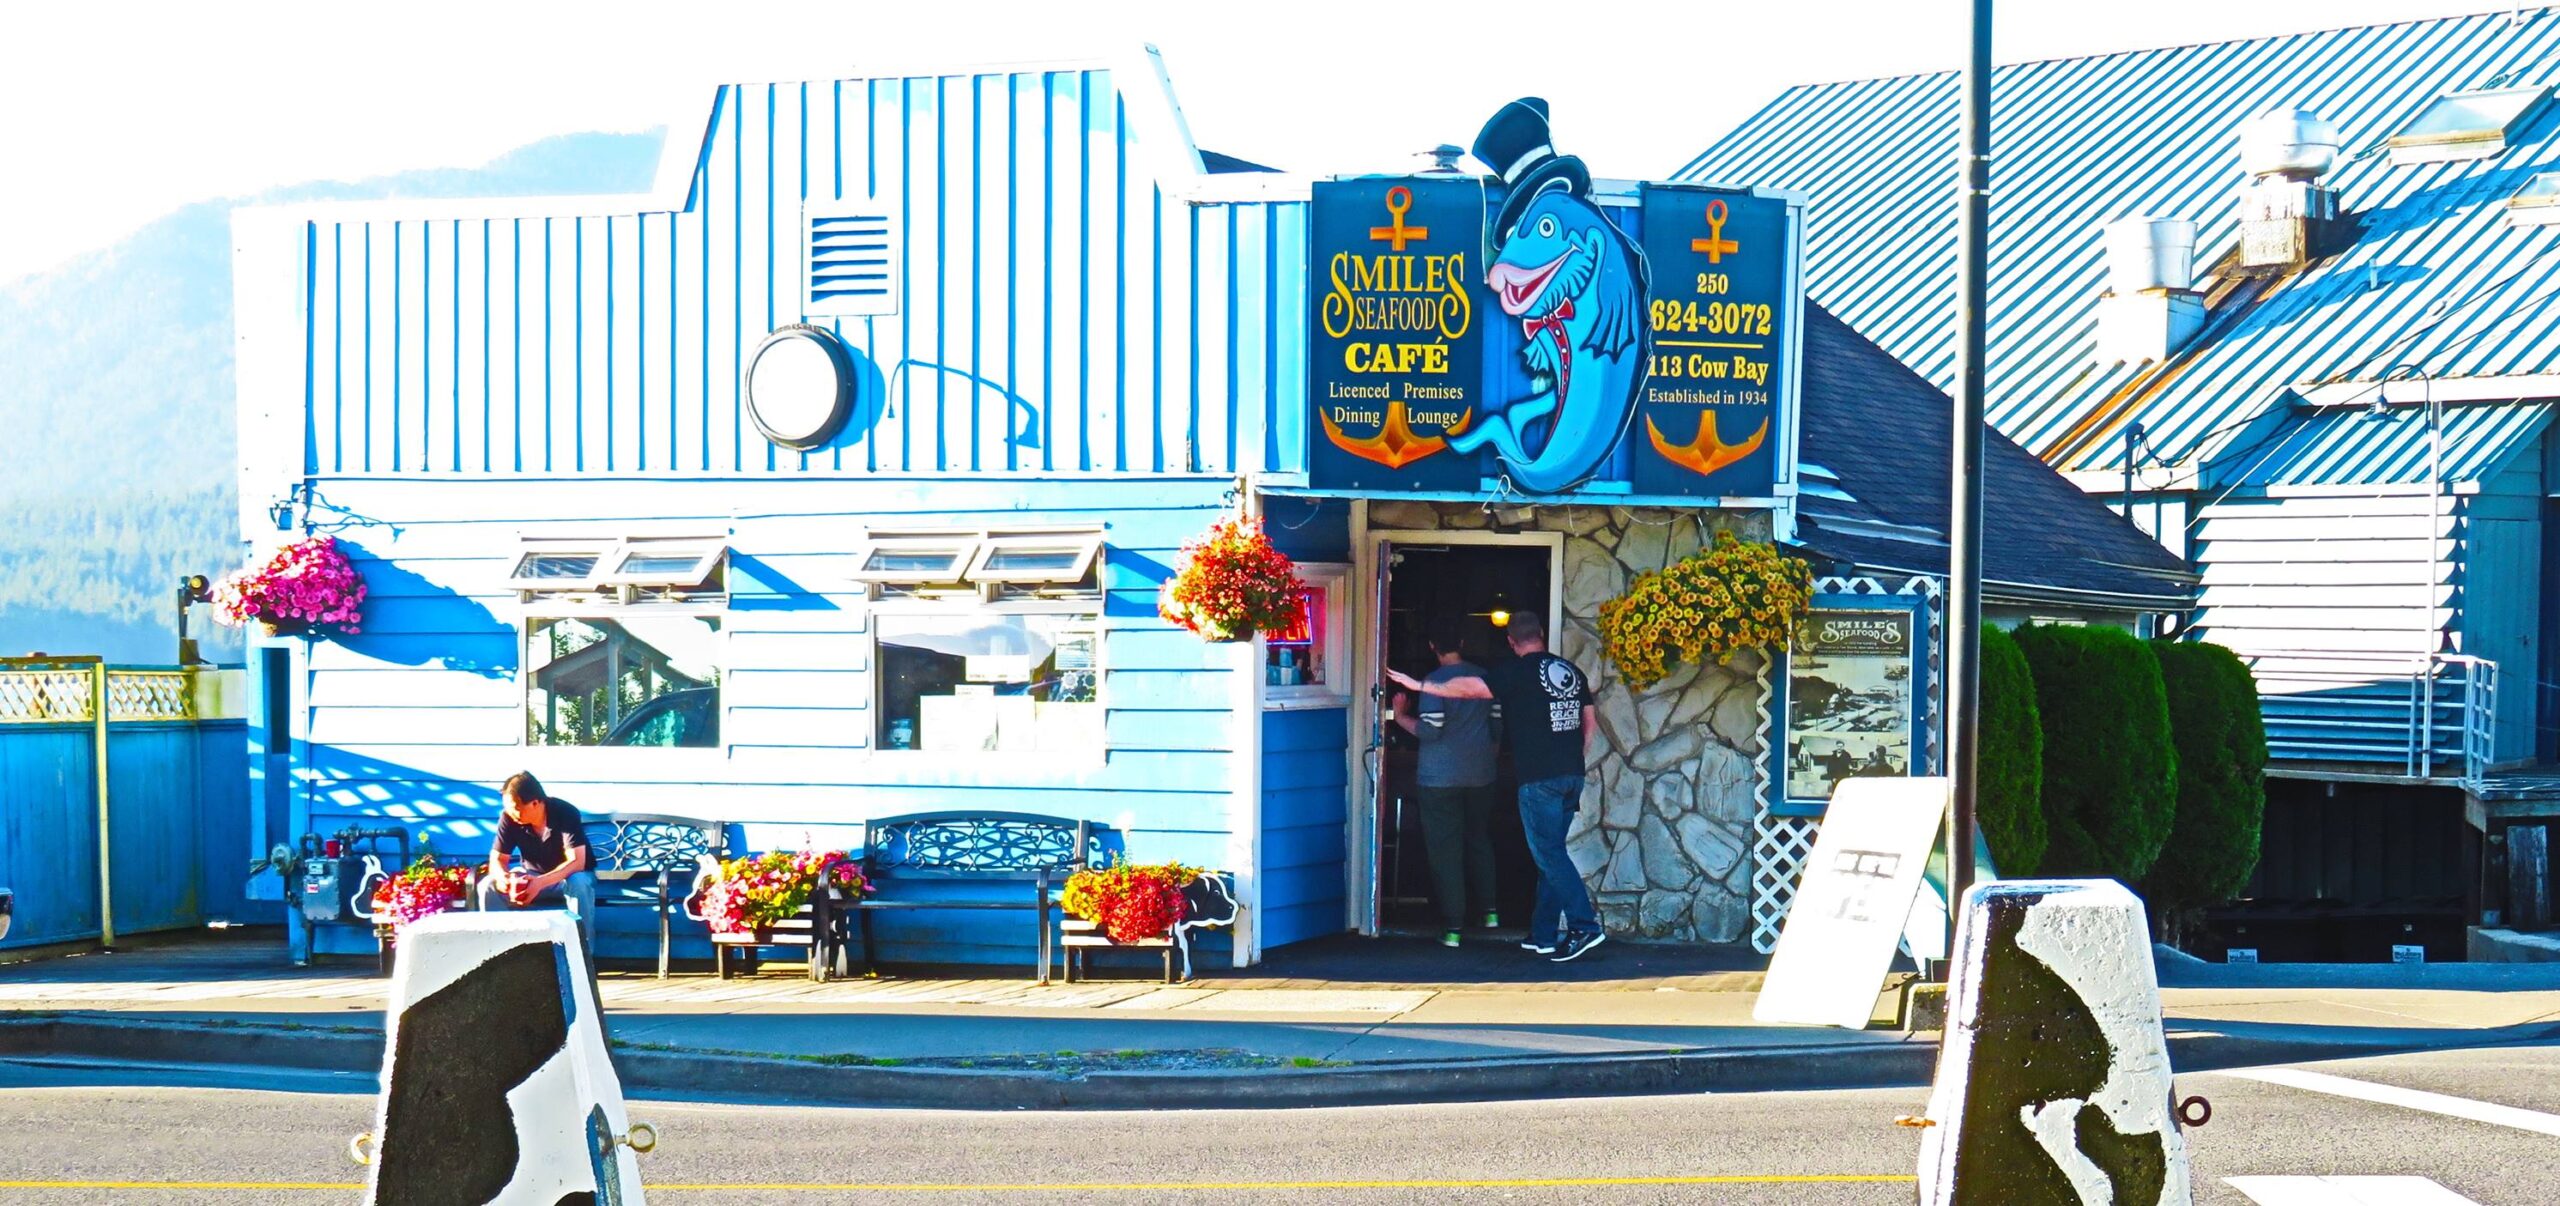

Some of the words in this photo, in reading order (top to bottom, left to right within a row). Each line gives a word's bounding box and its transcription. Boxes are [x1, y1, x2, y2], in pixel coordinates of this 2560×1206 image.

[1322, 251, 1470, 339] SMILES
[1697, 273, 1729, 295] 250
[1355, 296, 1437, 331] SEAFOOD
[1651, 300, 1771, 336] 624-3072
[1344, 336, 1449, 374] CAFÉ
[1648, 355, 1682, 378] 113
[1688, 354, 1729, 379] Cow
[1733, 355, 1769, 387] Bay
[1329, 382, 1390, 399] Licenced
[1403, 382, 1464, 399] Premises
[1648, 388, 1720, 404] Established
[1723, 390, 1735, 405] in
[1739, 390, 1768, 405] 1934
[1334, 407, 1380, 427] Dining
[1407, 407, 1458, 427] Lounge
[1549, 700, 1580, 710] RENZO
